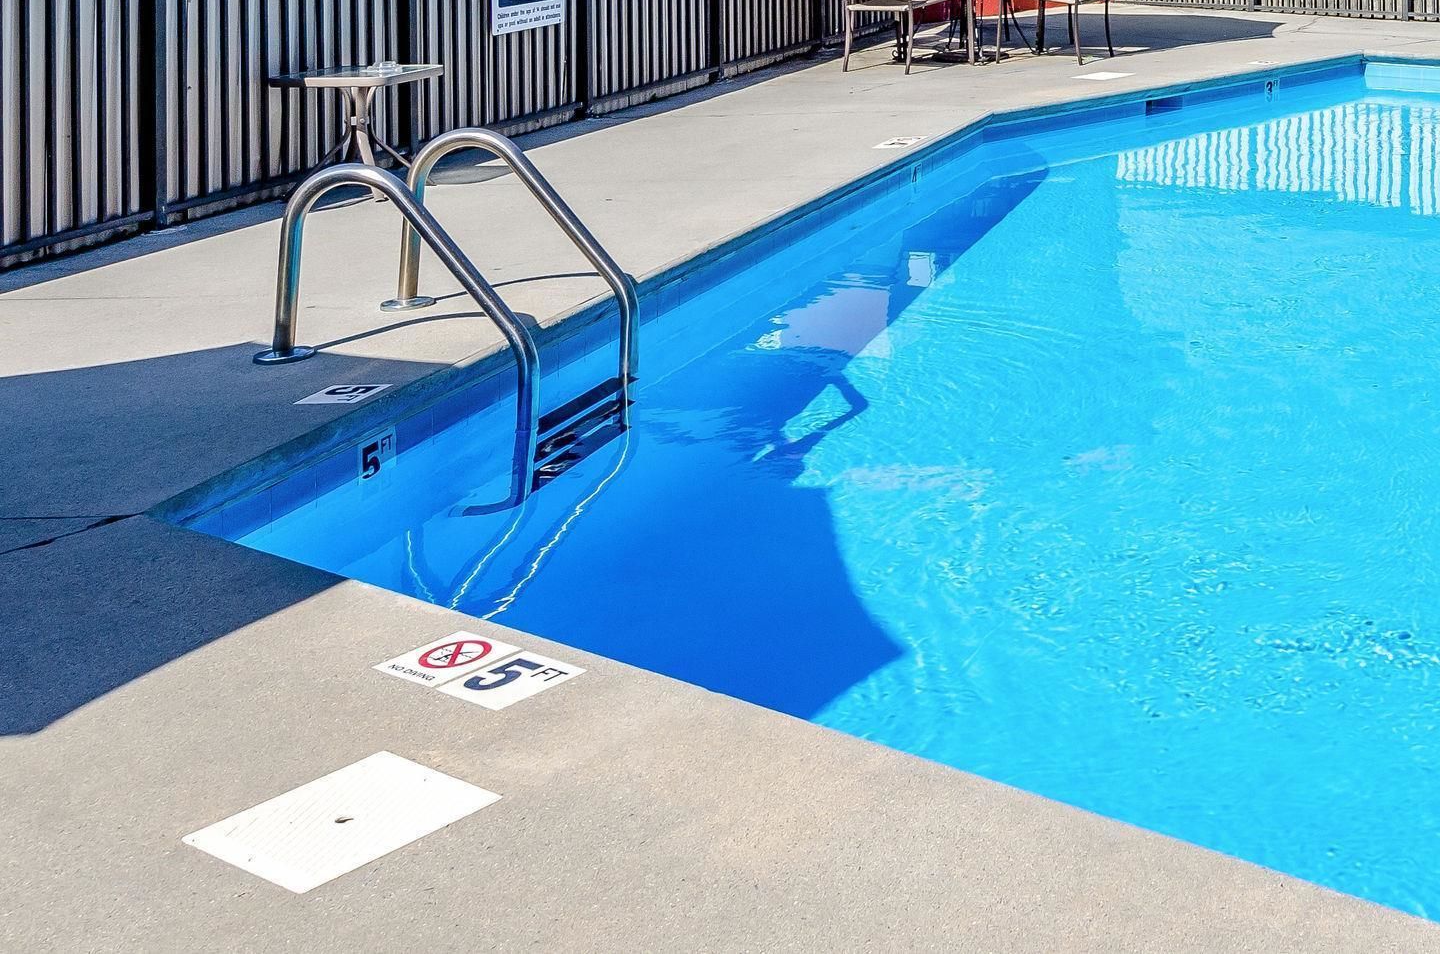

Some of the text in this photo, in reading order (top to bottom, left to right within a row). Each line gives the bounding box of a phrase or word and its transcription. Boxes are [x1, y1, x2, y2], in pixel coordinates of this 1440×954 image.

[324, 385, 380, 396] 5
[362, 434, 393, 480] 5 FT
[387, 663, 436, 681] NO DIVING
[463, 658, 569, 691] 5 FT
